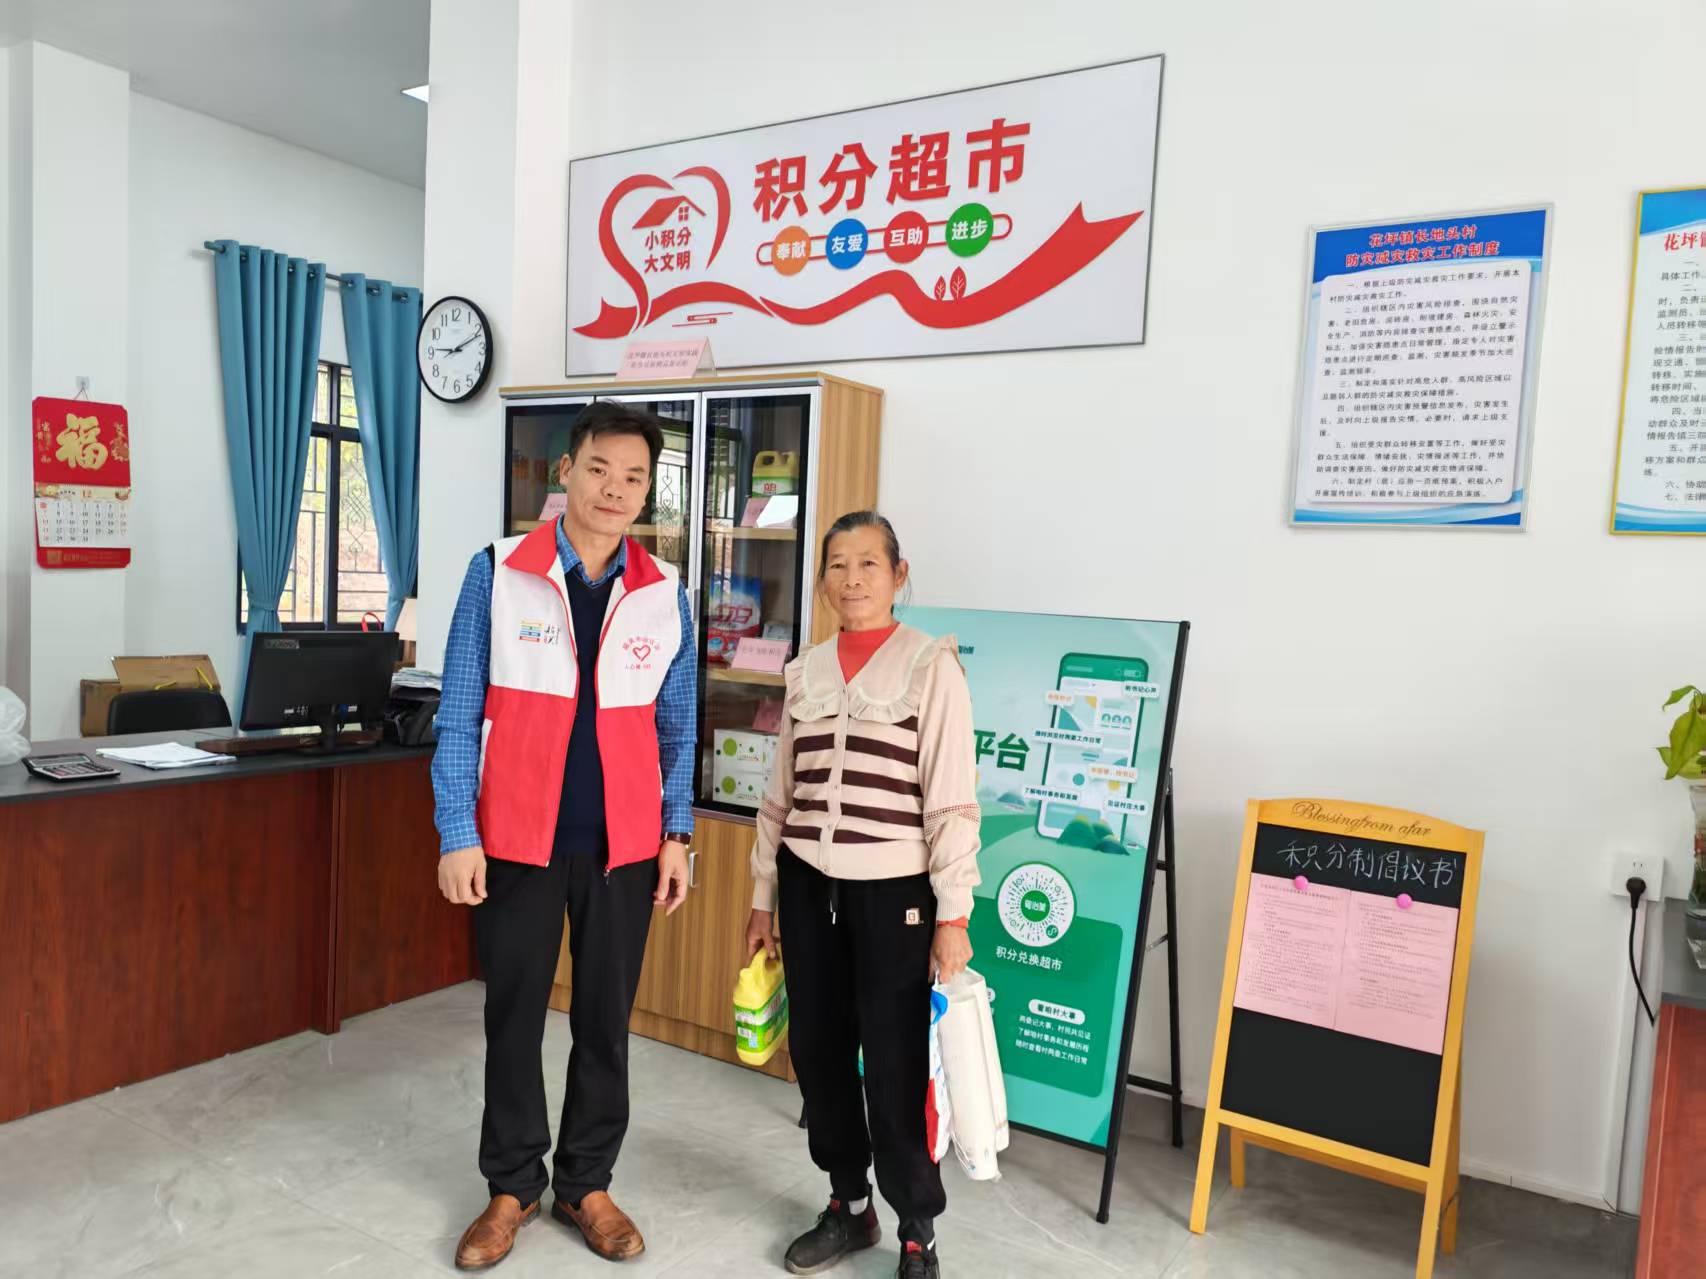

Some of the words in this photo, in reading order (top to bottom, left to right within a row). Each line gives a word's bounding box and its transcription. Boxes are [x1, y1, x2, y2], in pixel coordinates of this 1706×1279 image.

[753, 117, 1031, 223] 积分超市
[645, 227, 692, 249] 小积分
[776, 239, 807, 260] 奉献
[831, 233, 864, 255] 友爱
[889, 225, 923, 247] 互助
[951, 218, 988, 241] 进步
[1368, 224, 1478, 248] 花坪镇长地头村
[644, 251, 691, 273] 大文明
[1345, 240, 1501, 268] 防灾减灾救灾工作制度
[55, 412, 108, 471] 福
[973, 729, 1031, 771] 平台
[1398, 820, 1432, 837] afar
[1277, 838, 1458, 889] 积分制倡议书
[996, 945, 1063, 972] 积分兑换超市
